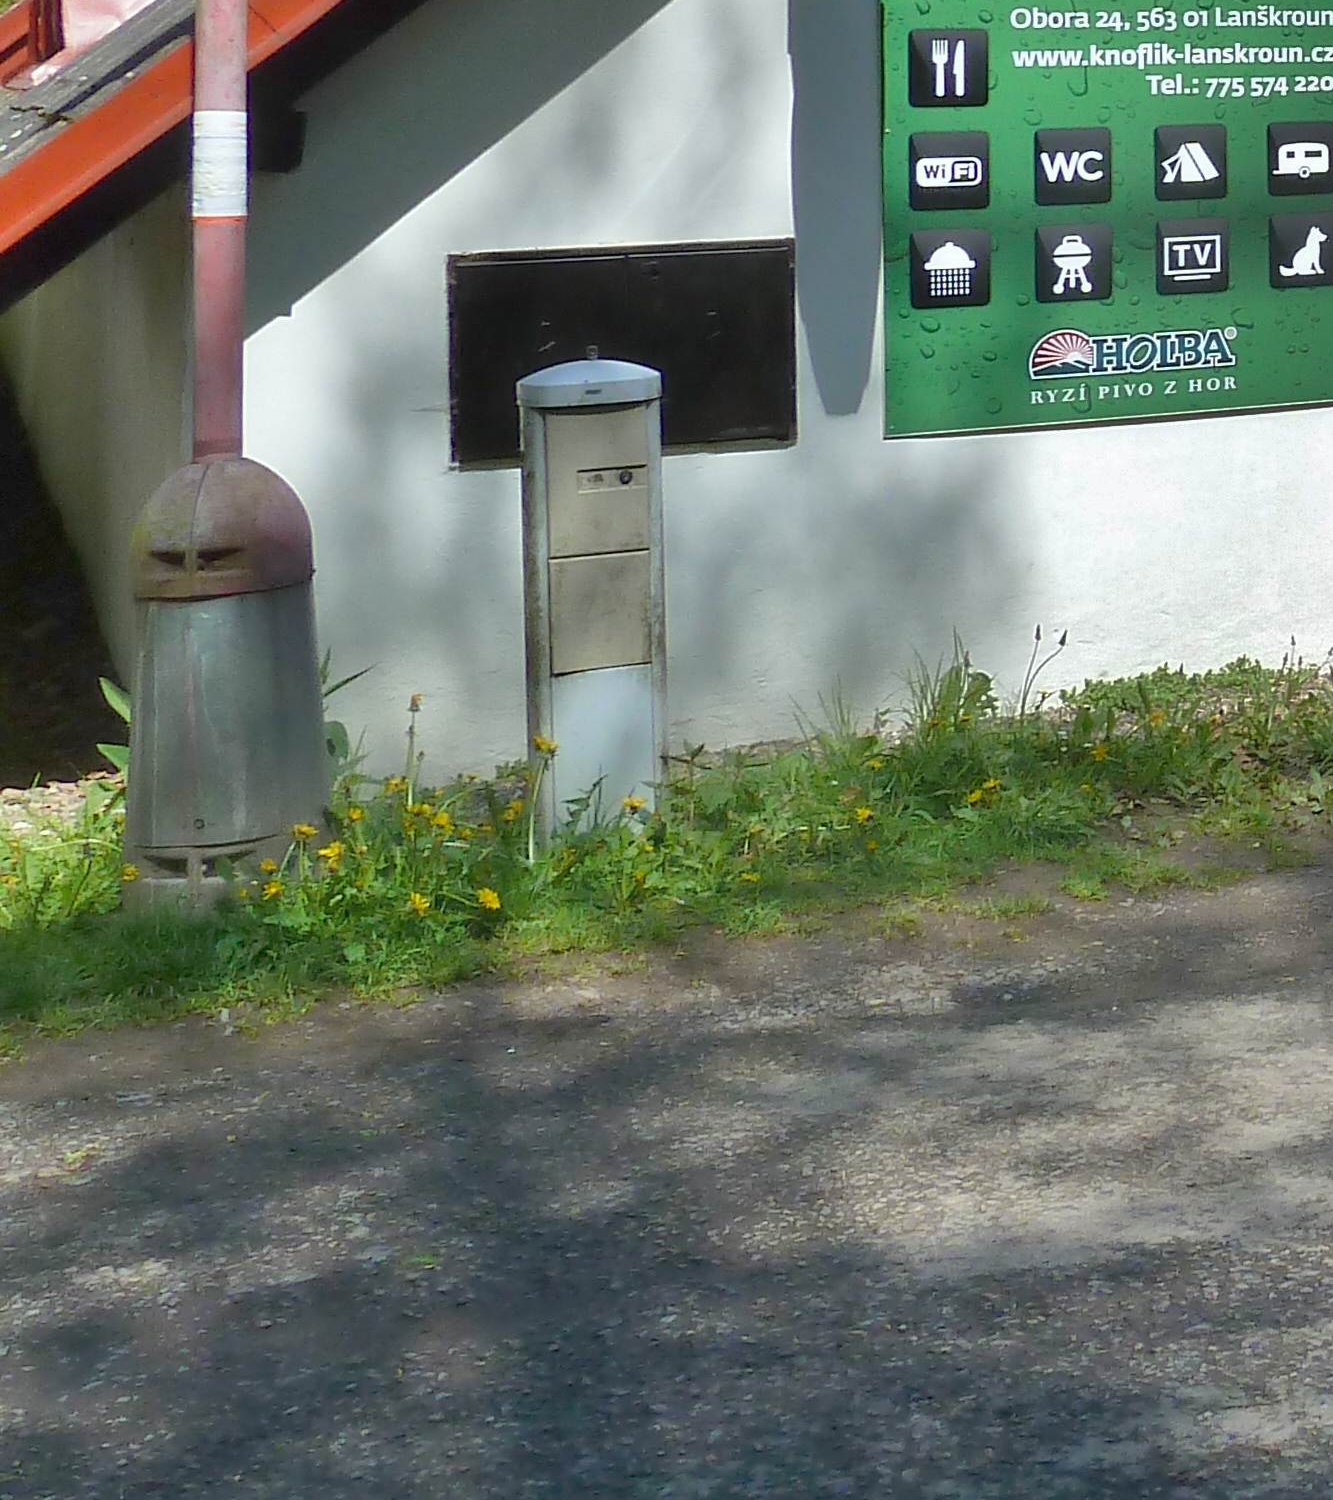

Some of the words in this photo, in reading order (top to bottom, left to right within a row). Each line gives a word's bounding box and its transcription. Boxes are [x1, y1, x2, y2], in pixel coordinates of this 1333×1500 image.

[1009, 7, 1090, 29] Obora
[1095, 11, 1131, 32] 24,
[1136, 7, 1177, 31] 563
[1145, 73, 1199, 95] Tel.:
[1205, 77, 1244, 98] 775
[1250, 76, 1289, 97] 574
[1040, 150, 1104, 182] WC
[1172, 244, 1211, 269] TV
[1091, 328, 1237, 374] HOLBA
[1030, 382, 1088, 405] RYZÍ
[1098, 382, 1153, 400] PIVO
[1163, 380, 1178, 395] Z
[1188, 375, 1238, 393] HOR
